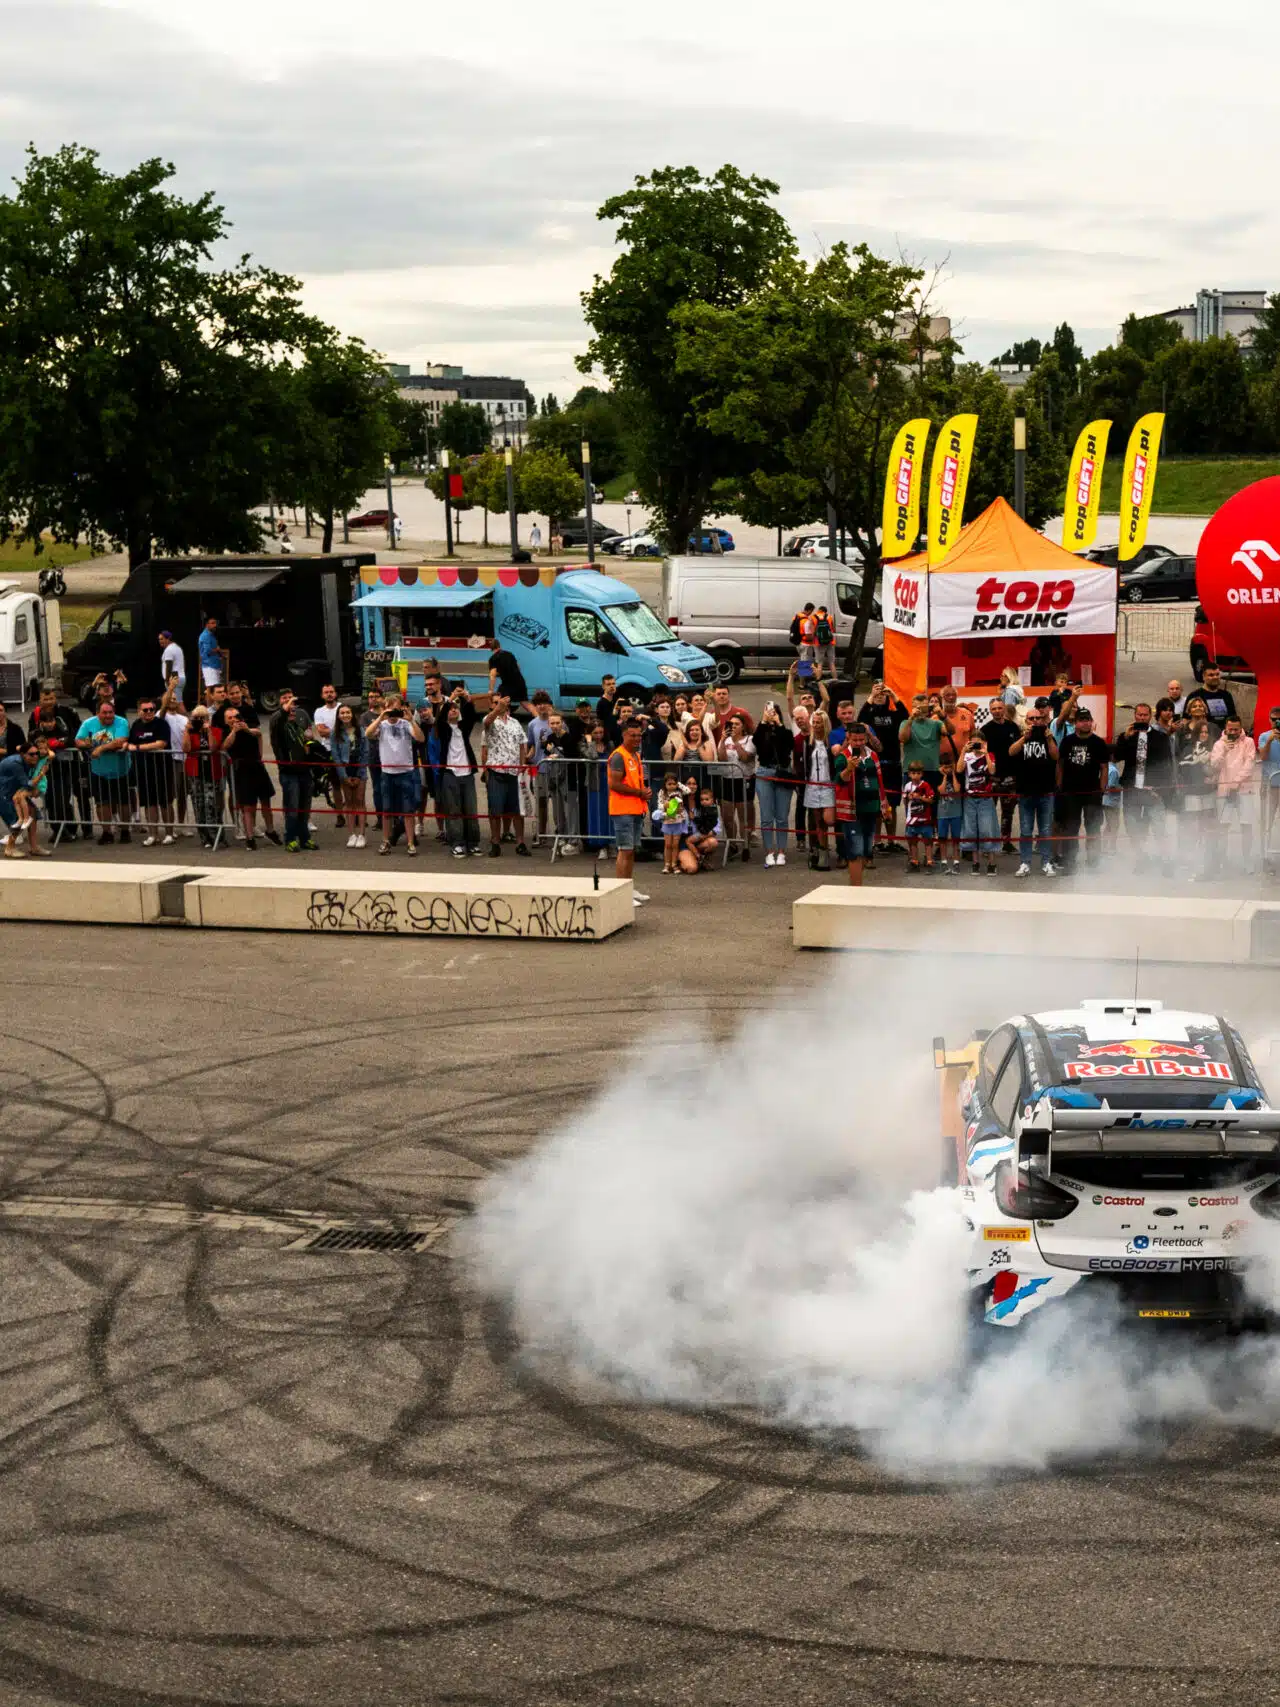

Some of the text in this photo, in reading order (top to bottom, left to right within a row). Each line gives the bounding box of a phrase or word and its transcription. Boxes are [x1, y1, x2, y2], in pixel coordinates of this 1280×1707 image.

[893, 573, 919, 610] top
[976, 577, 1075, 612] top
[893, 608, 917, 628] RACING
[970, 612, 1068, 631] RACING
[1064, 1059, 1150, 1079] Red
[1149, 1059, 1233, 1080] Bull
[1104, 1195, 1145, 1206] Castrol
[1200, 1195, 1239, 1206] Castrol
[987, 1229, 1027, 1239] PIRELLI
[1152, 1237, 1204, 1247] Fleetback
